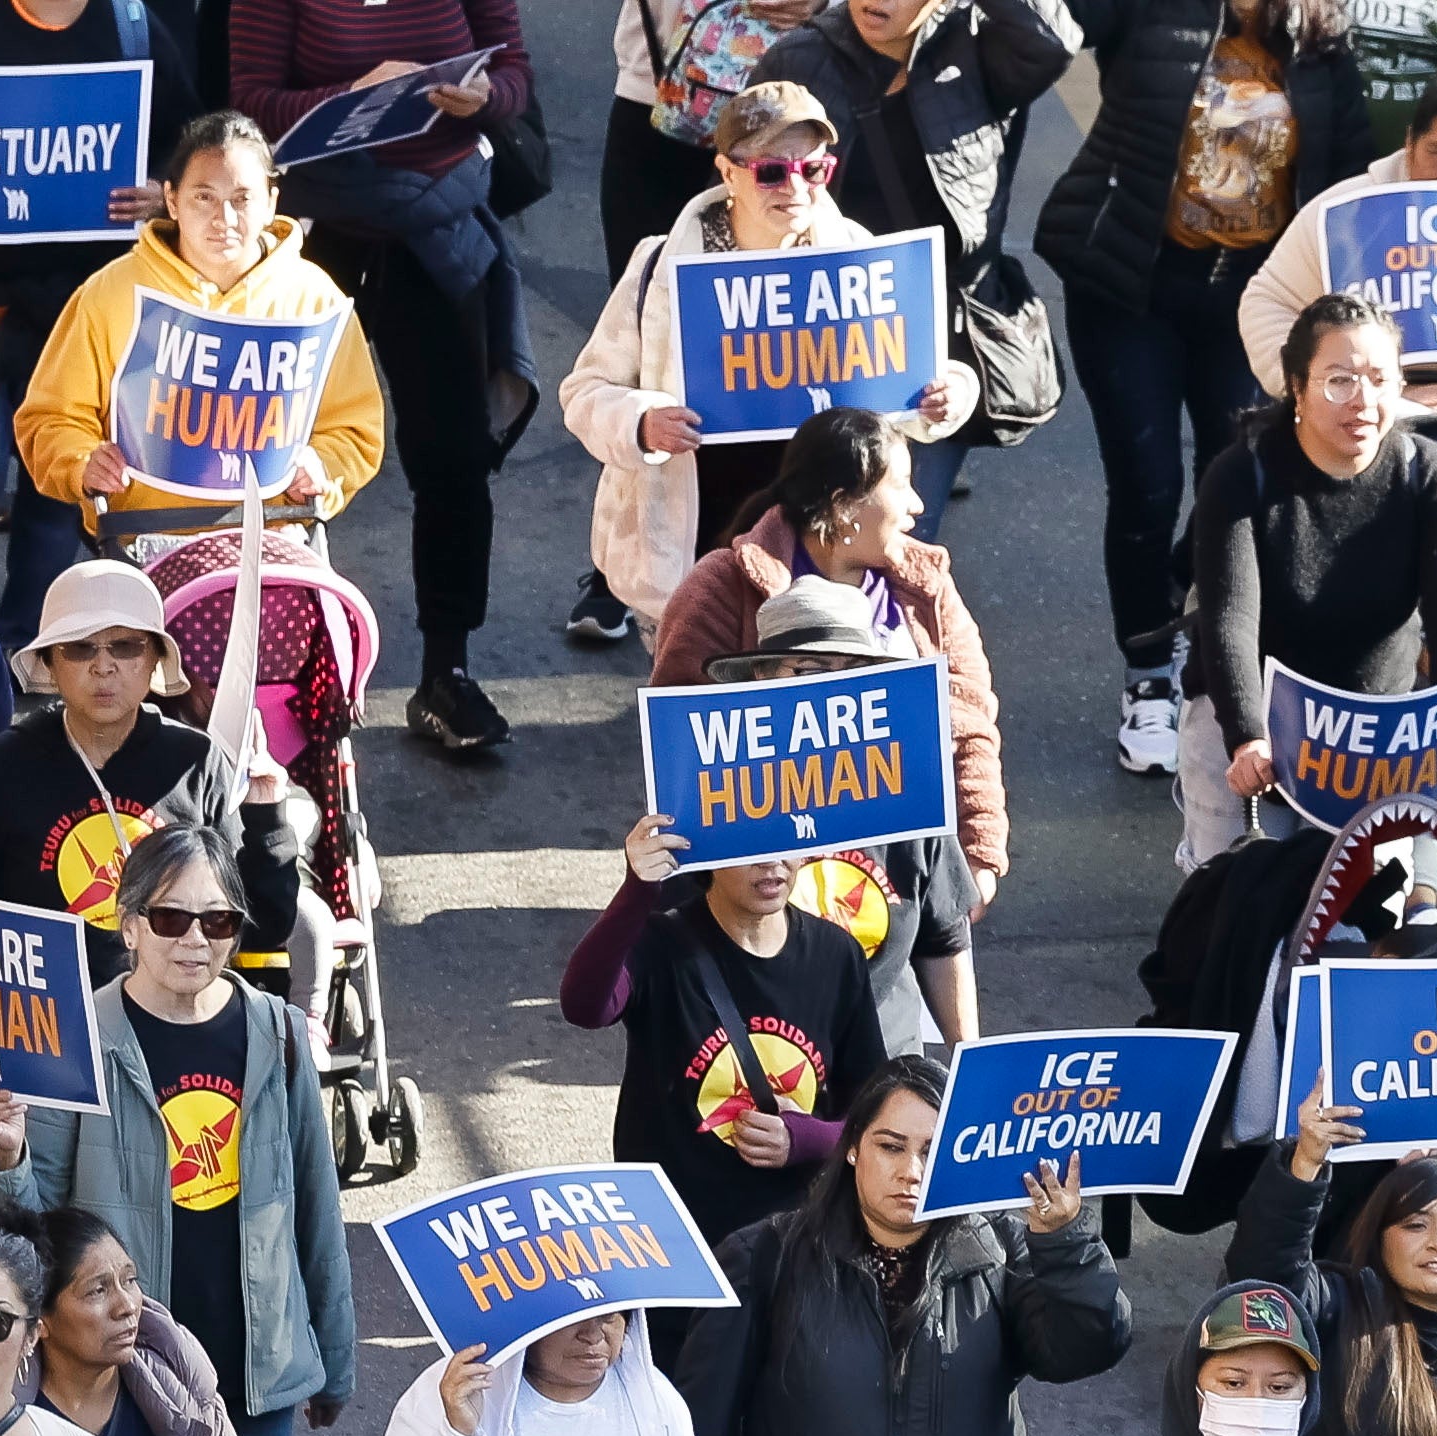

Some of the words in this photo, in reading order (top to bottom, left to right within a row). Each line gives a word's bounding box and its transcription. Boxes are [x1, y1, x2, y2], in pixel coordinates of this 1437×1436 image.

[714, 273, 792, 330] WE
[805, 257, 897, 321] ARE
[155, 319, 222, 389] WE
[228, 335, 321, 392] ARE
[721, 314, 907, 392] HUMAN
[145, 377, 313, 452] HUMAN
[688, 705, 776, 767] WE
[788, 687, 892, 754] ARE
[1304, 698, 1379, 754] WE
[698, 741, 904, 828] HUMAN
[39, 815, 72, 872] TSURU
[685, 1027, 730, 1082] TSURU
[1039, 1050, 1117, 1092] ICE
[951, 1109, 1162, 1165] CALIFORNIA
[1012, 1088, 1077, 1117] OUT
[1082, 1086, 1122, 1113] OF
[427, 1197, 531, 1262] WE
[533, 1179, 637, 1235] ARE
[455, 1220, 672, 1315] HUMAN
